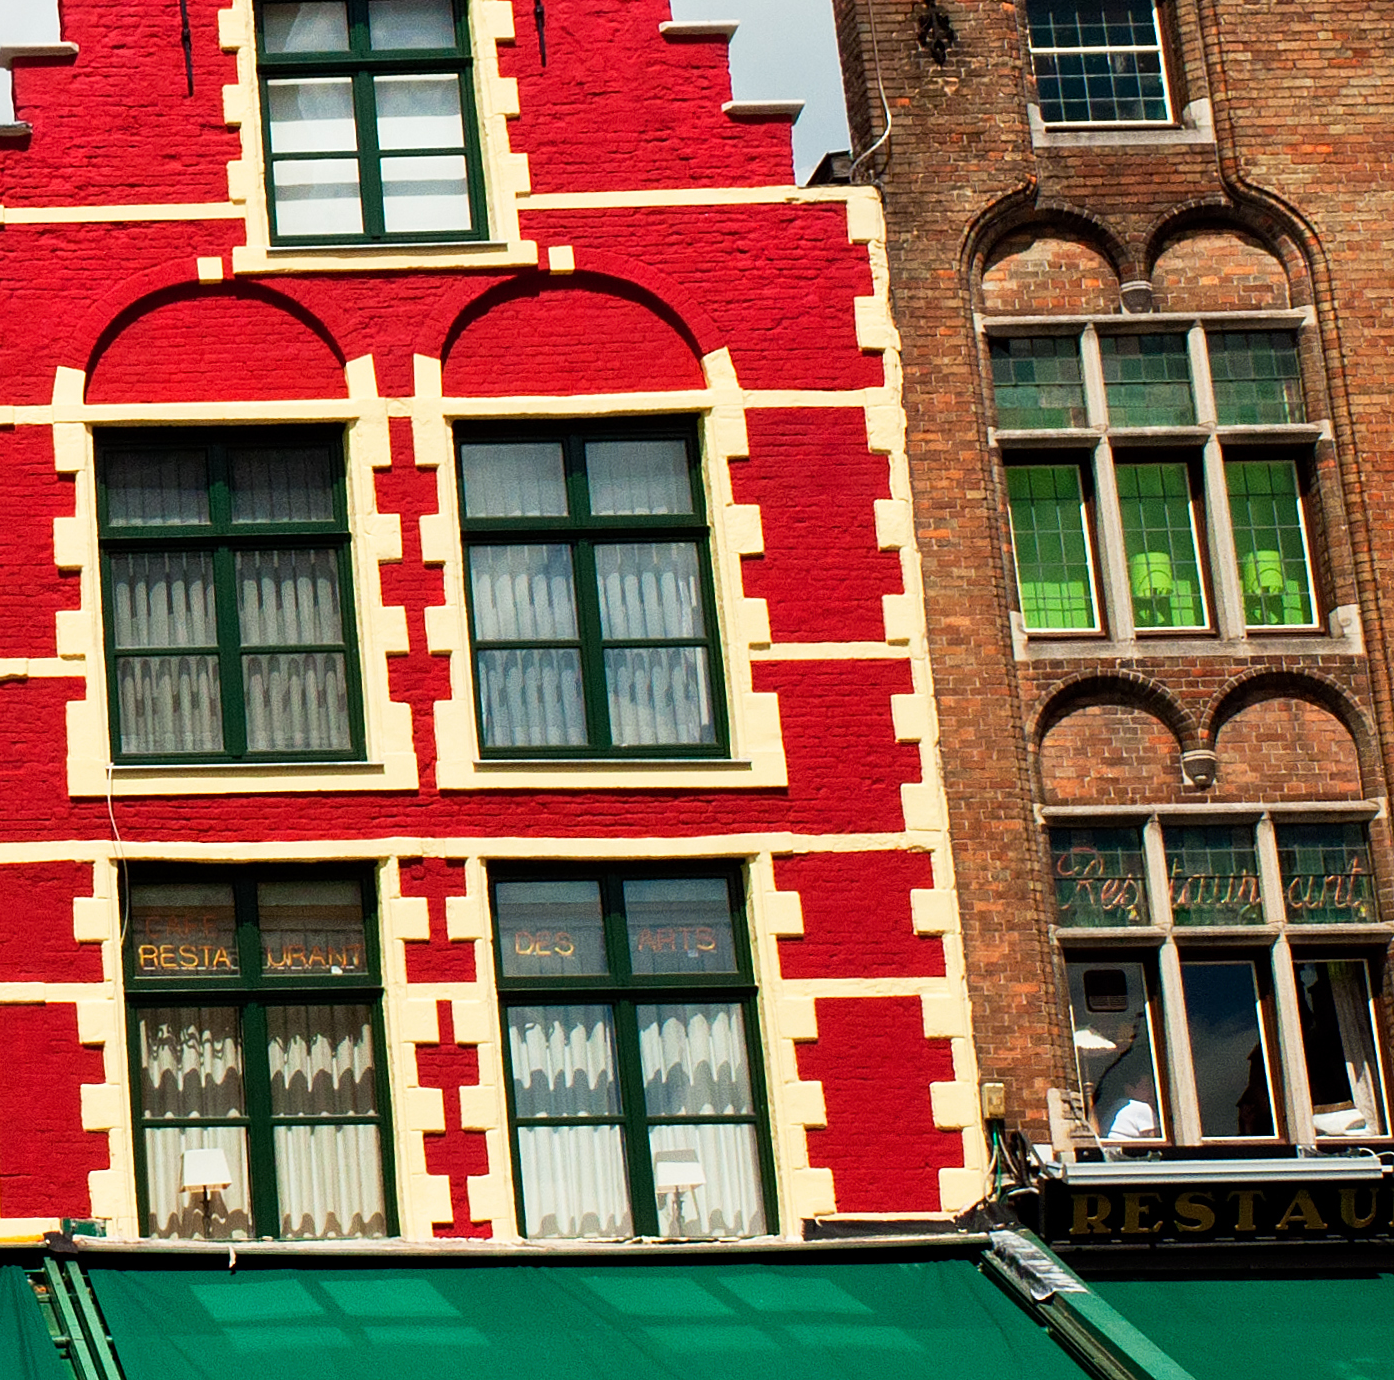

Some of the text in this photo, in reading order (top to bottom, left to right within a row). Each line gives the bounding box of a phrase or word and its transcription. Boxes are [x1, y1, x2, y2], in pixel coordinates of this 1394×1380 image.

[515, 926, 716, 956] DES ARTS
[1069, 1188, 1394, 1235] RESTAU
